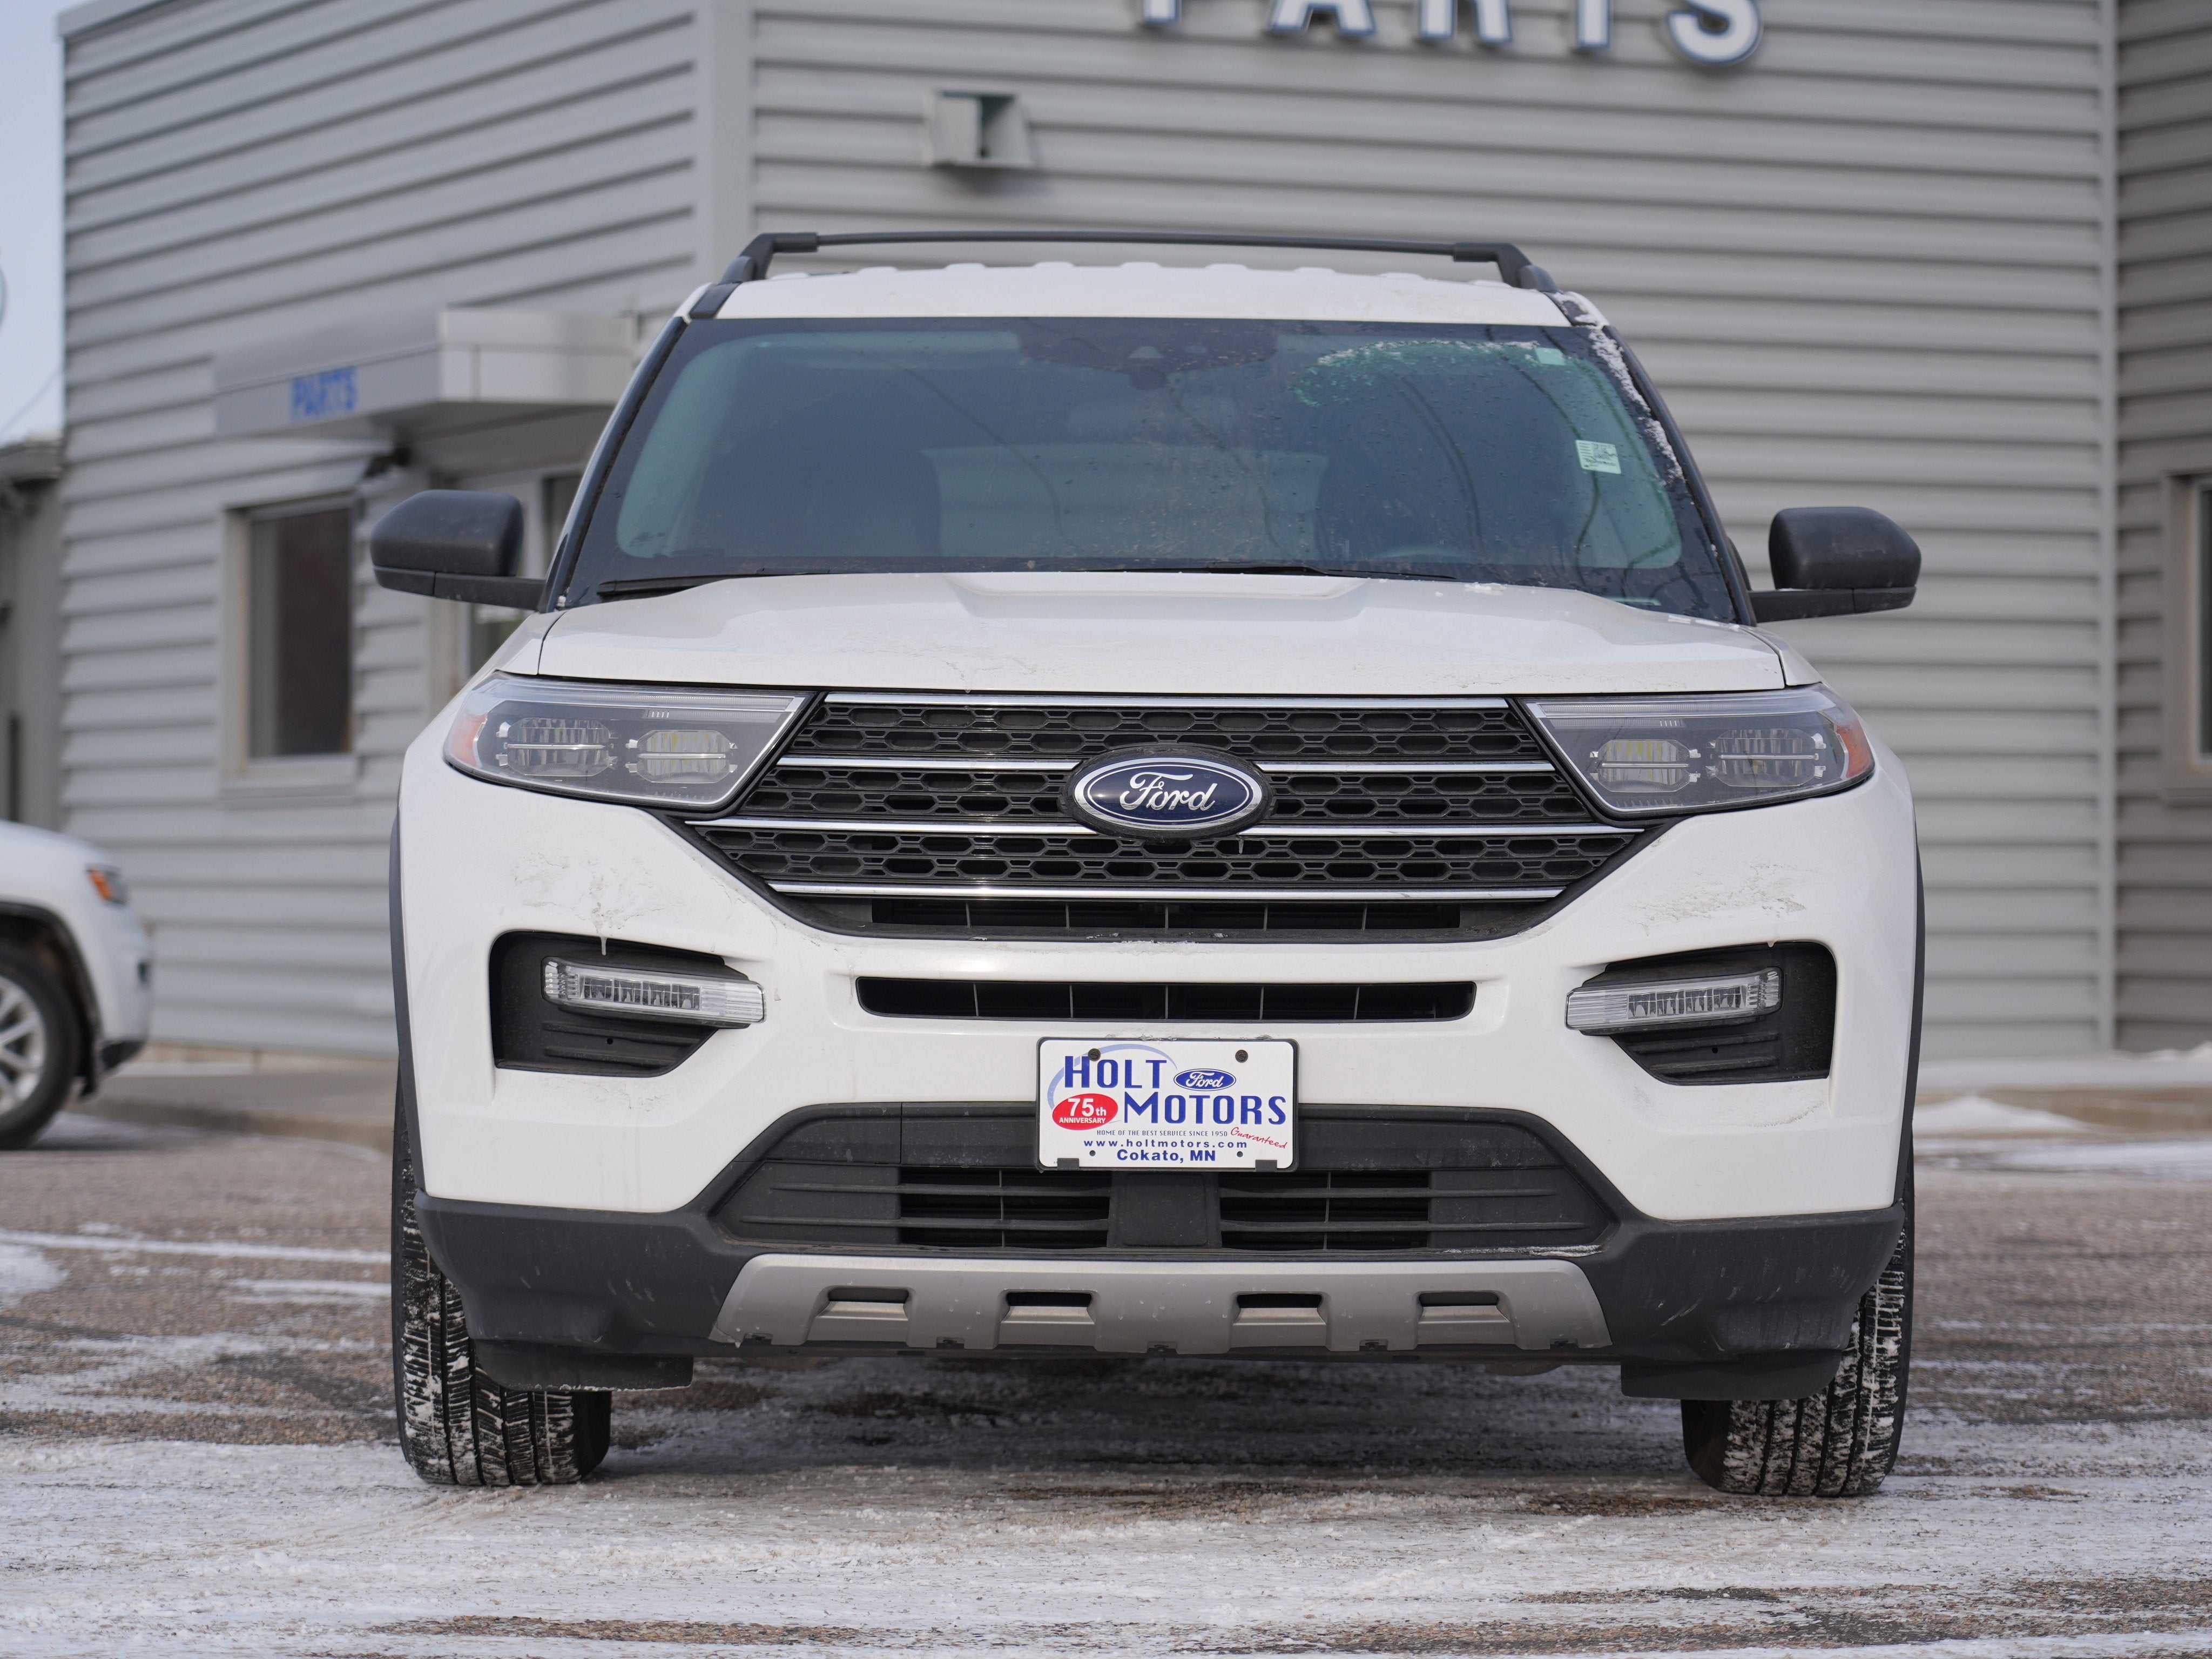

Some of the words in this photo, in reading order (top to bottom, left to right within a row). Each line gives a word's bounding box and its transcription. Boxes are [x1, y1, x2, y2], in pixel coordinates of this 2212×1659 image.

[292, 367, 357, 421] PARTS
[1120, 771, 1218, 811] Ford
[1065, 1056, 1166, 1088] HOLT
[1185, 1071, 1224, 1088] Ford
[1068, 1098, 1107, 1117] 75th
[1124, 1091, 1286, 1125] MOTORS
[1083, 1139, 1247, 1148] www.holtmotors.com
[1230, 1127, 1288, 1149] Guaranteed
[1117, 1149, 1184, 1163] Cokato,
[1190, 1150, 1216, 1161] MN
